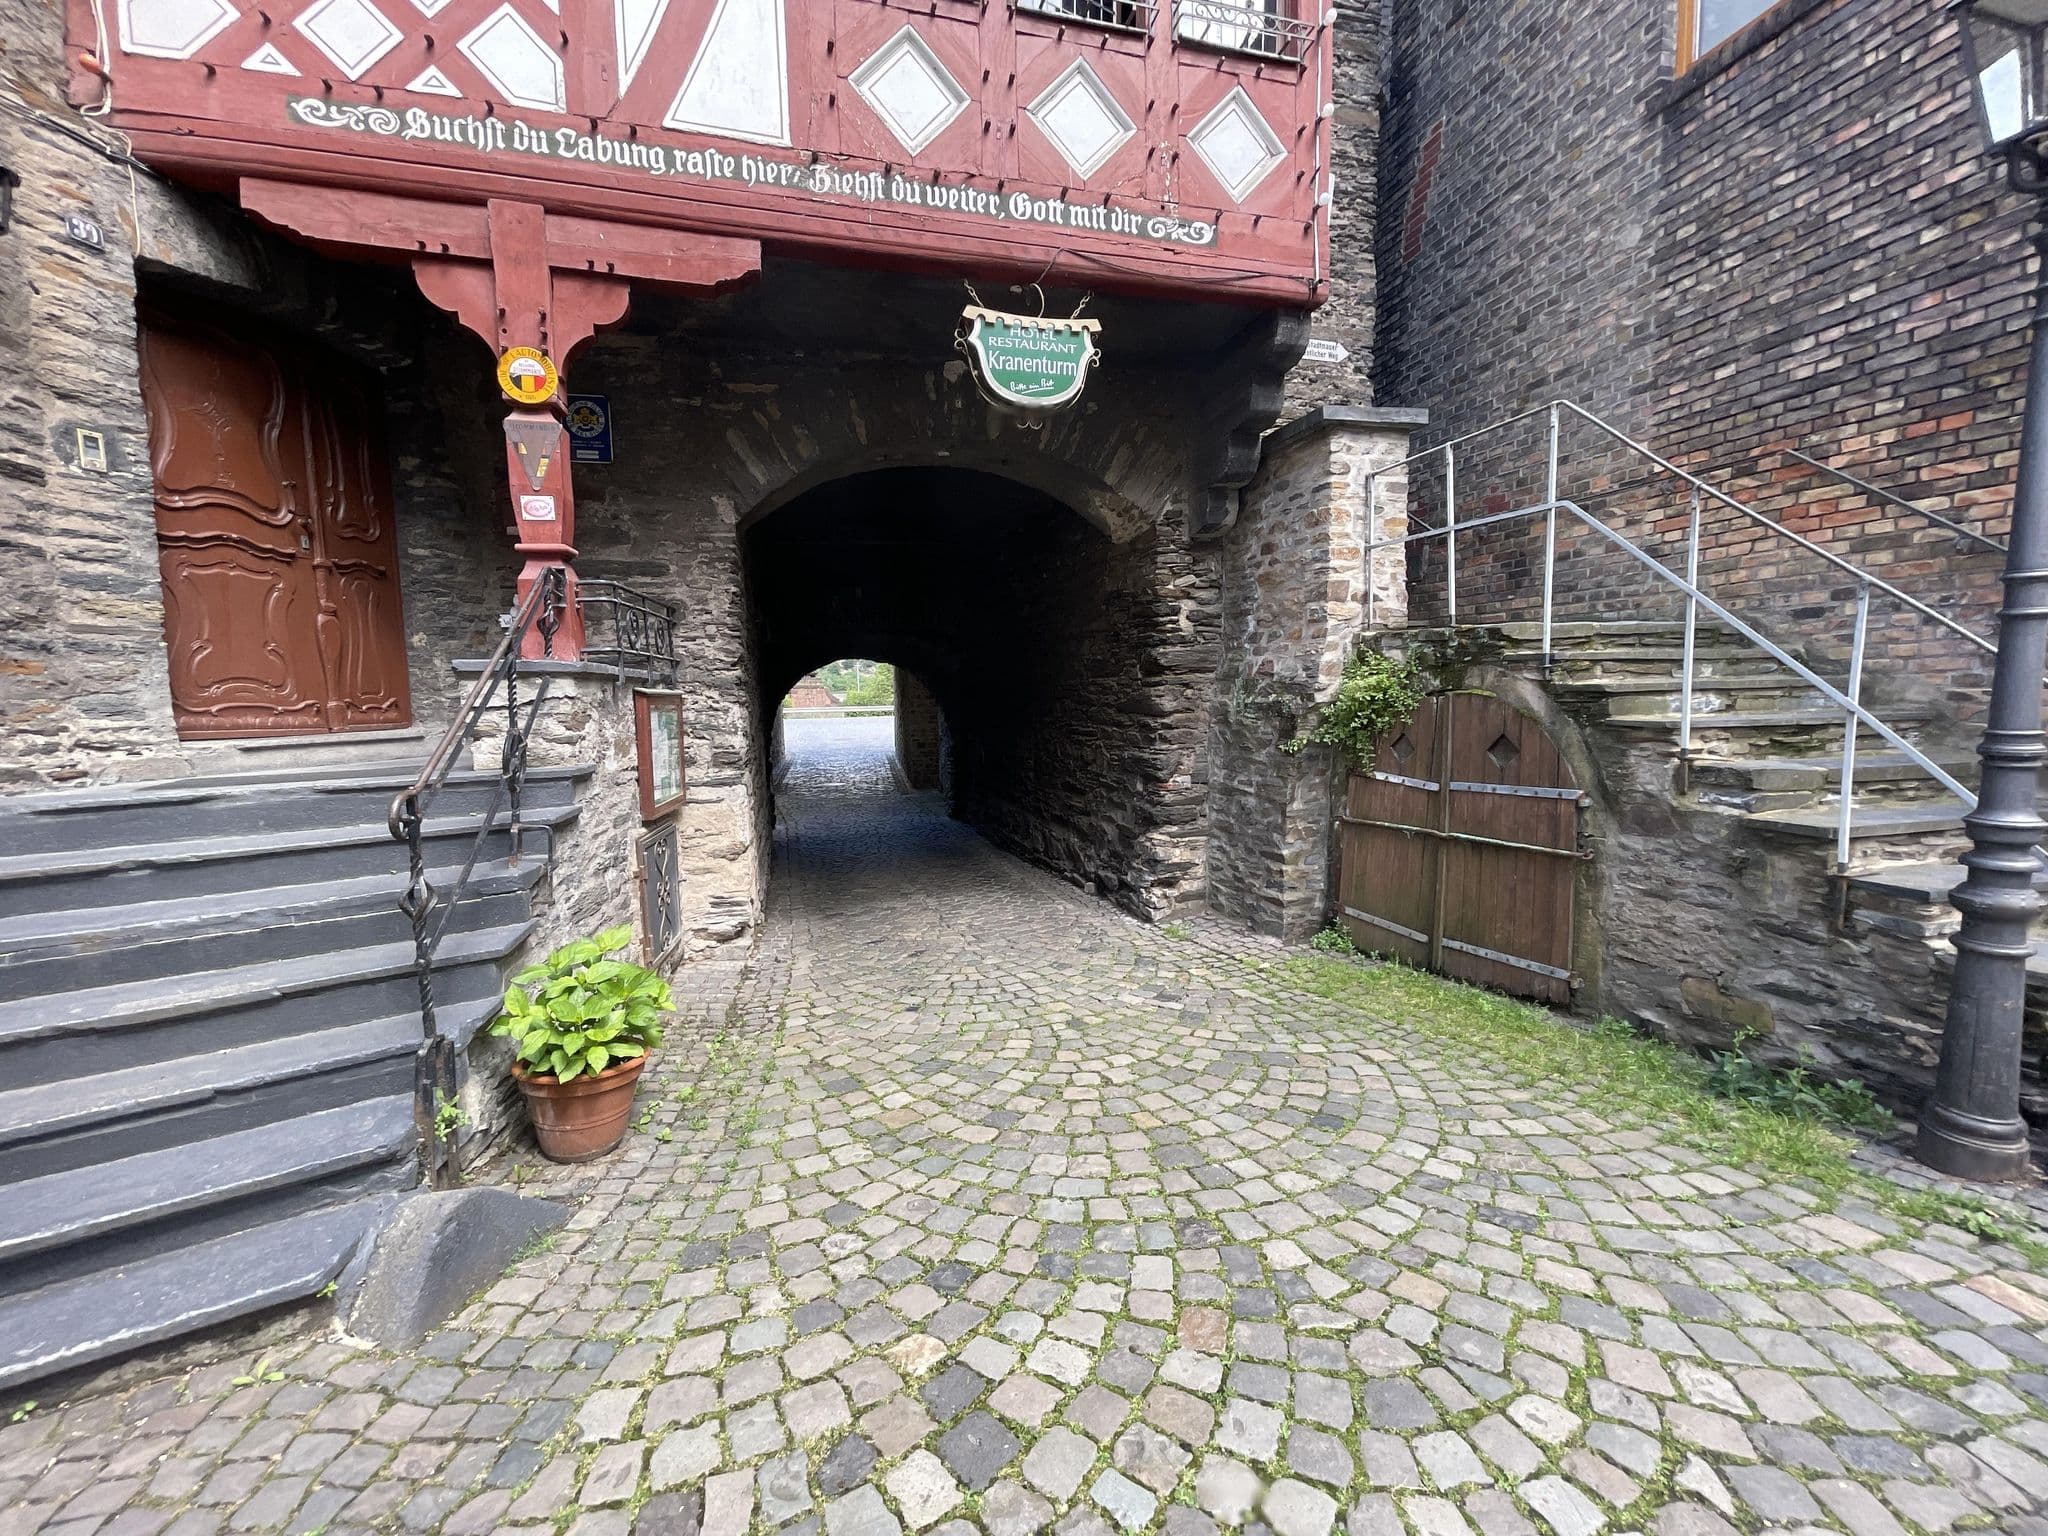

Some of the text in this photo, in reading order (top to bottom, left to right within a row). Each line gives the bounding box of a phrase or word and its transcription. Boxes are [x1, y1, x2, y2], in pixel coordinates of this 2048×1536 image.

[513, 119, 550, 154] du
[891, 174, 922, 204] du
[925, 183, 1006, 220] weiter,
[1009, 191, 1065, 225] Gott
[1068, 203, 1108, 231] mit
[1111, 205, 1142, 235] dir
[1010, 327, 1057, 341] HOTEL
[988, 336, 1078, 354] RESTAURANT
[988, 350, 1077, 376] Kranenturm
[1010, 381, 1027, 392] Bitte
